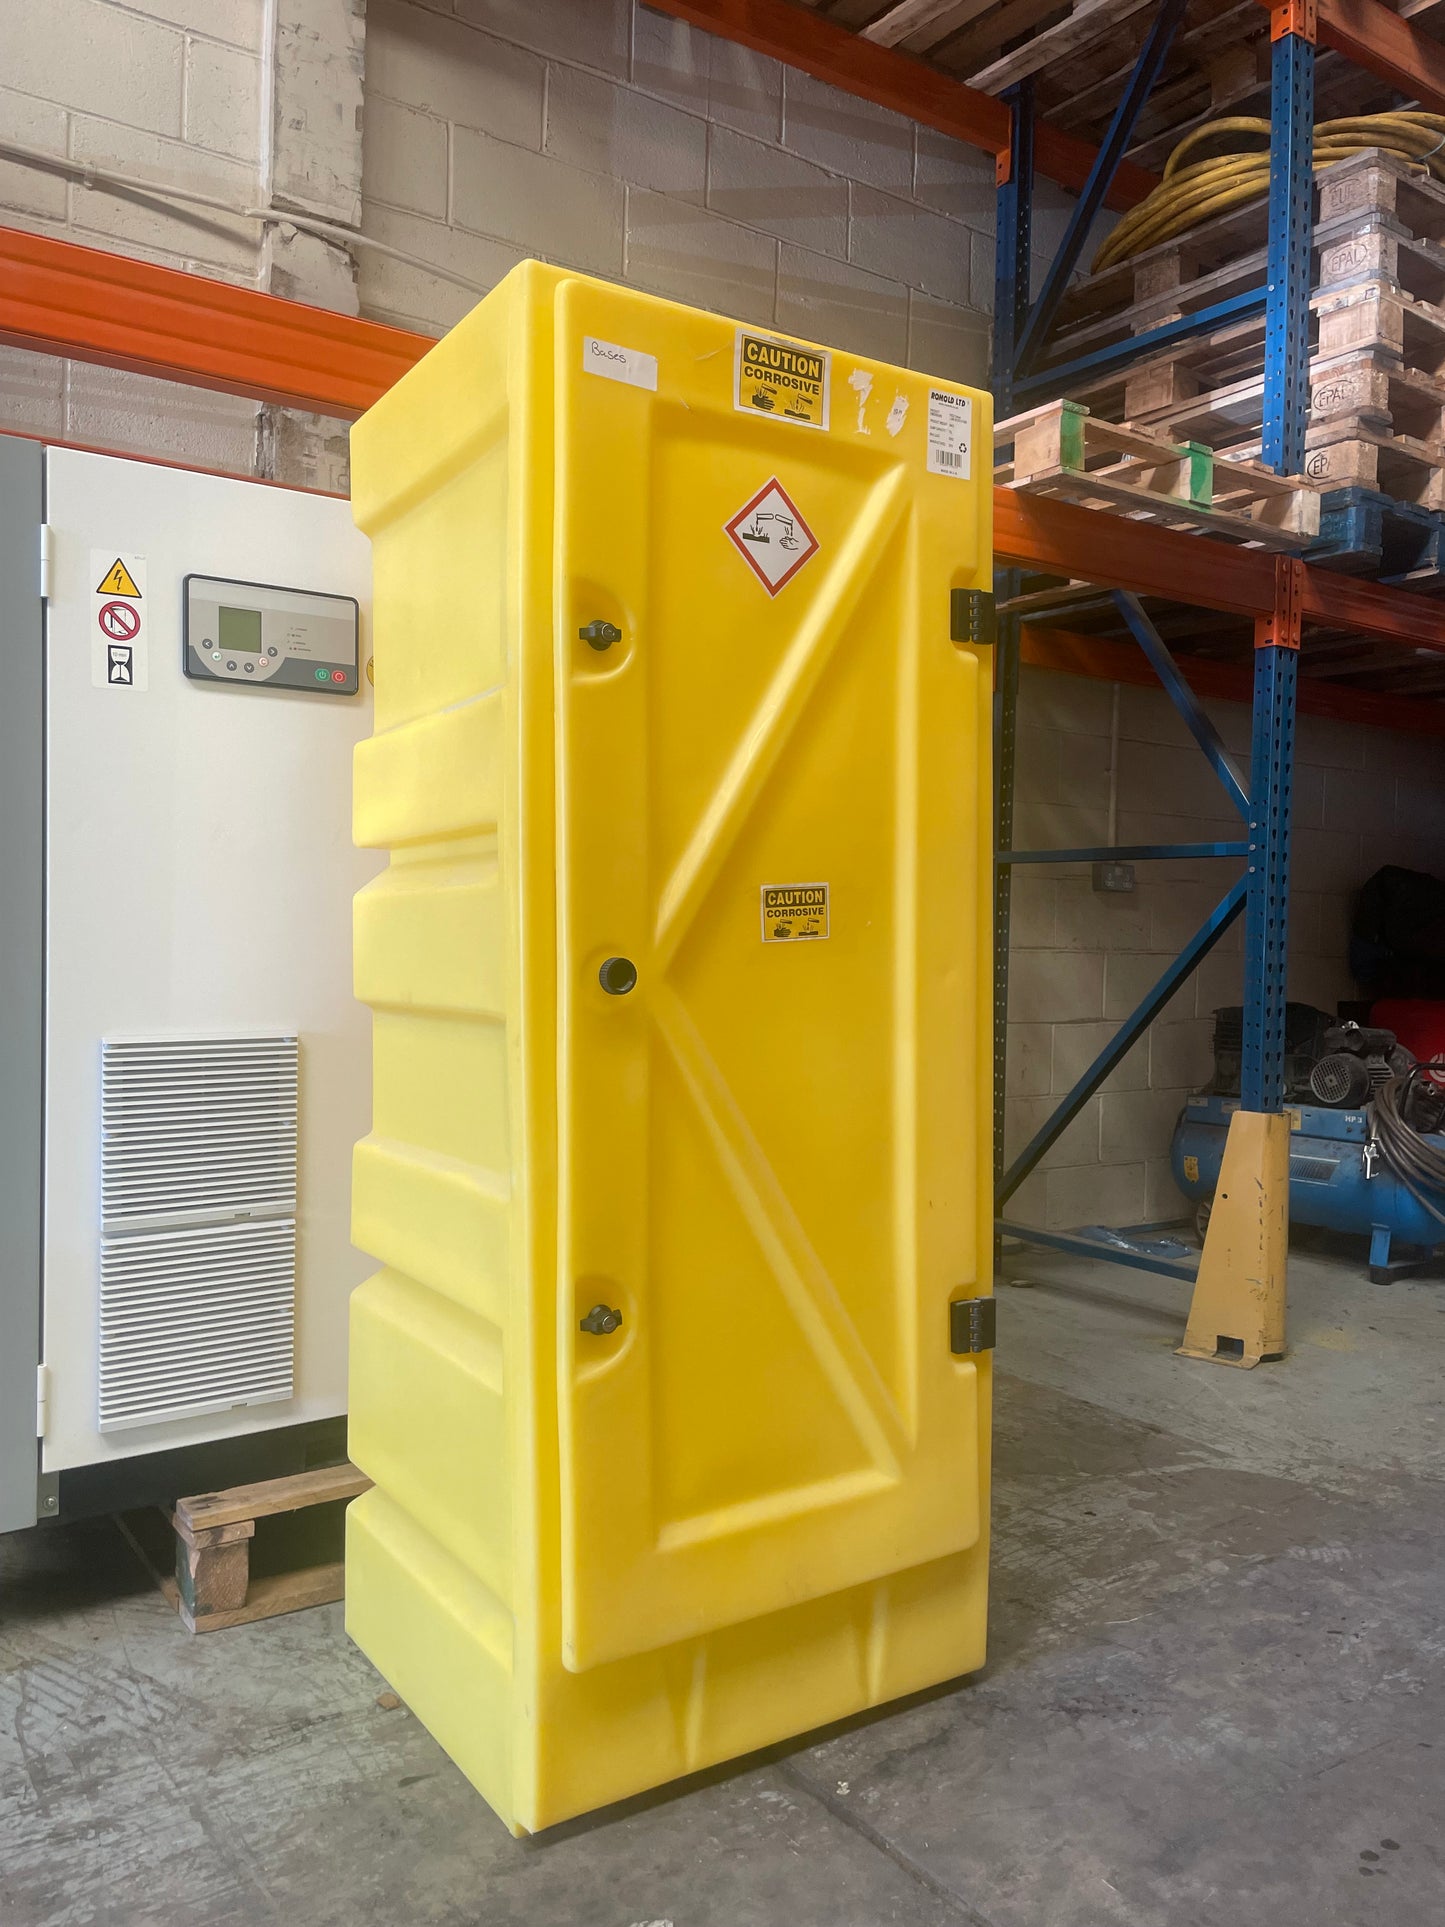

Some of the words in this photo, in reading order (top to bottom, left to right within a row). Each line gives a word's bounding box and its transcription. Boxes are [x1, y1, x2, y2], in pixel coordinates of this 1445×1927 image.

[1331, 248, 1361, 272] EPAL
[591, 341, 627, 364] Bases
[746, 342, 820, 379] CAUTION
[744, 365, 820, 395] CORROSIVE
[930, 391, 955, 404] ROMOLD
[955, 398, 966, 407] LTD
[767, 890, 823, 906] CAUTION
[766, 907, 824, 918] CORROSIVE
[1345, 1115, 1356, 1123] HP
